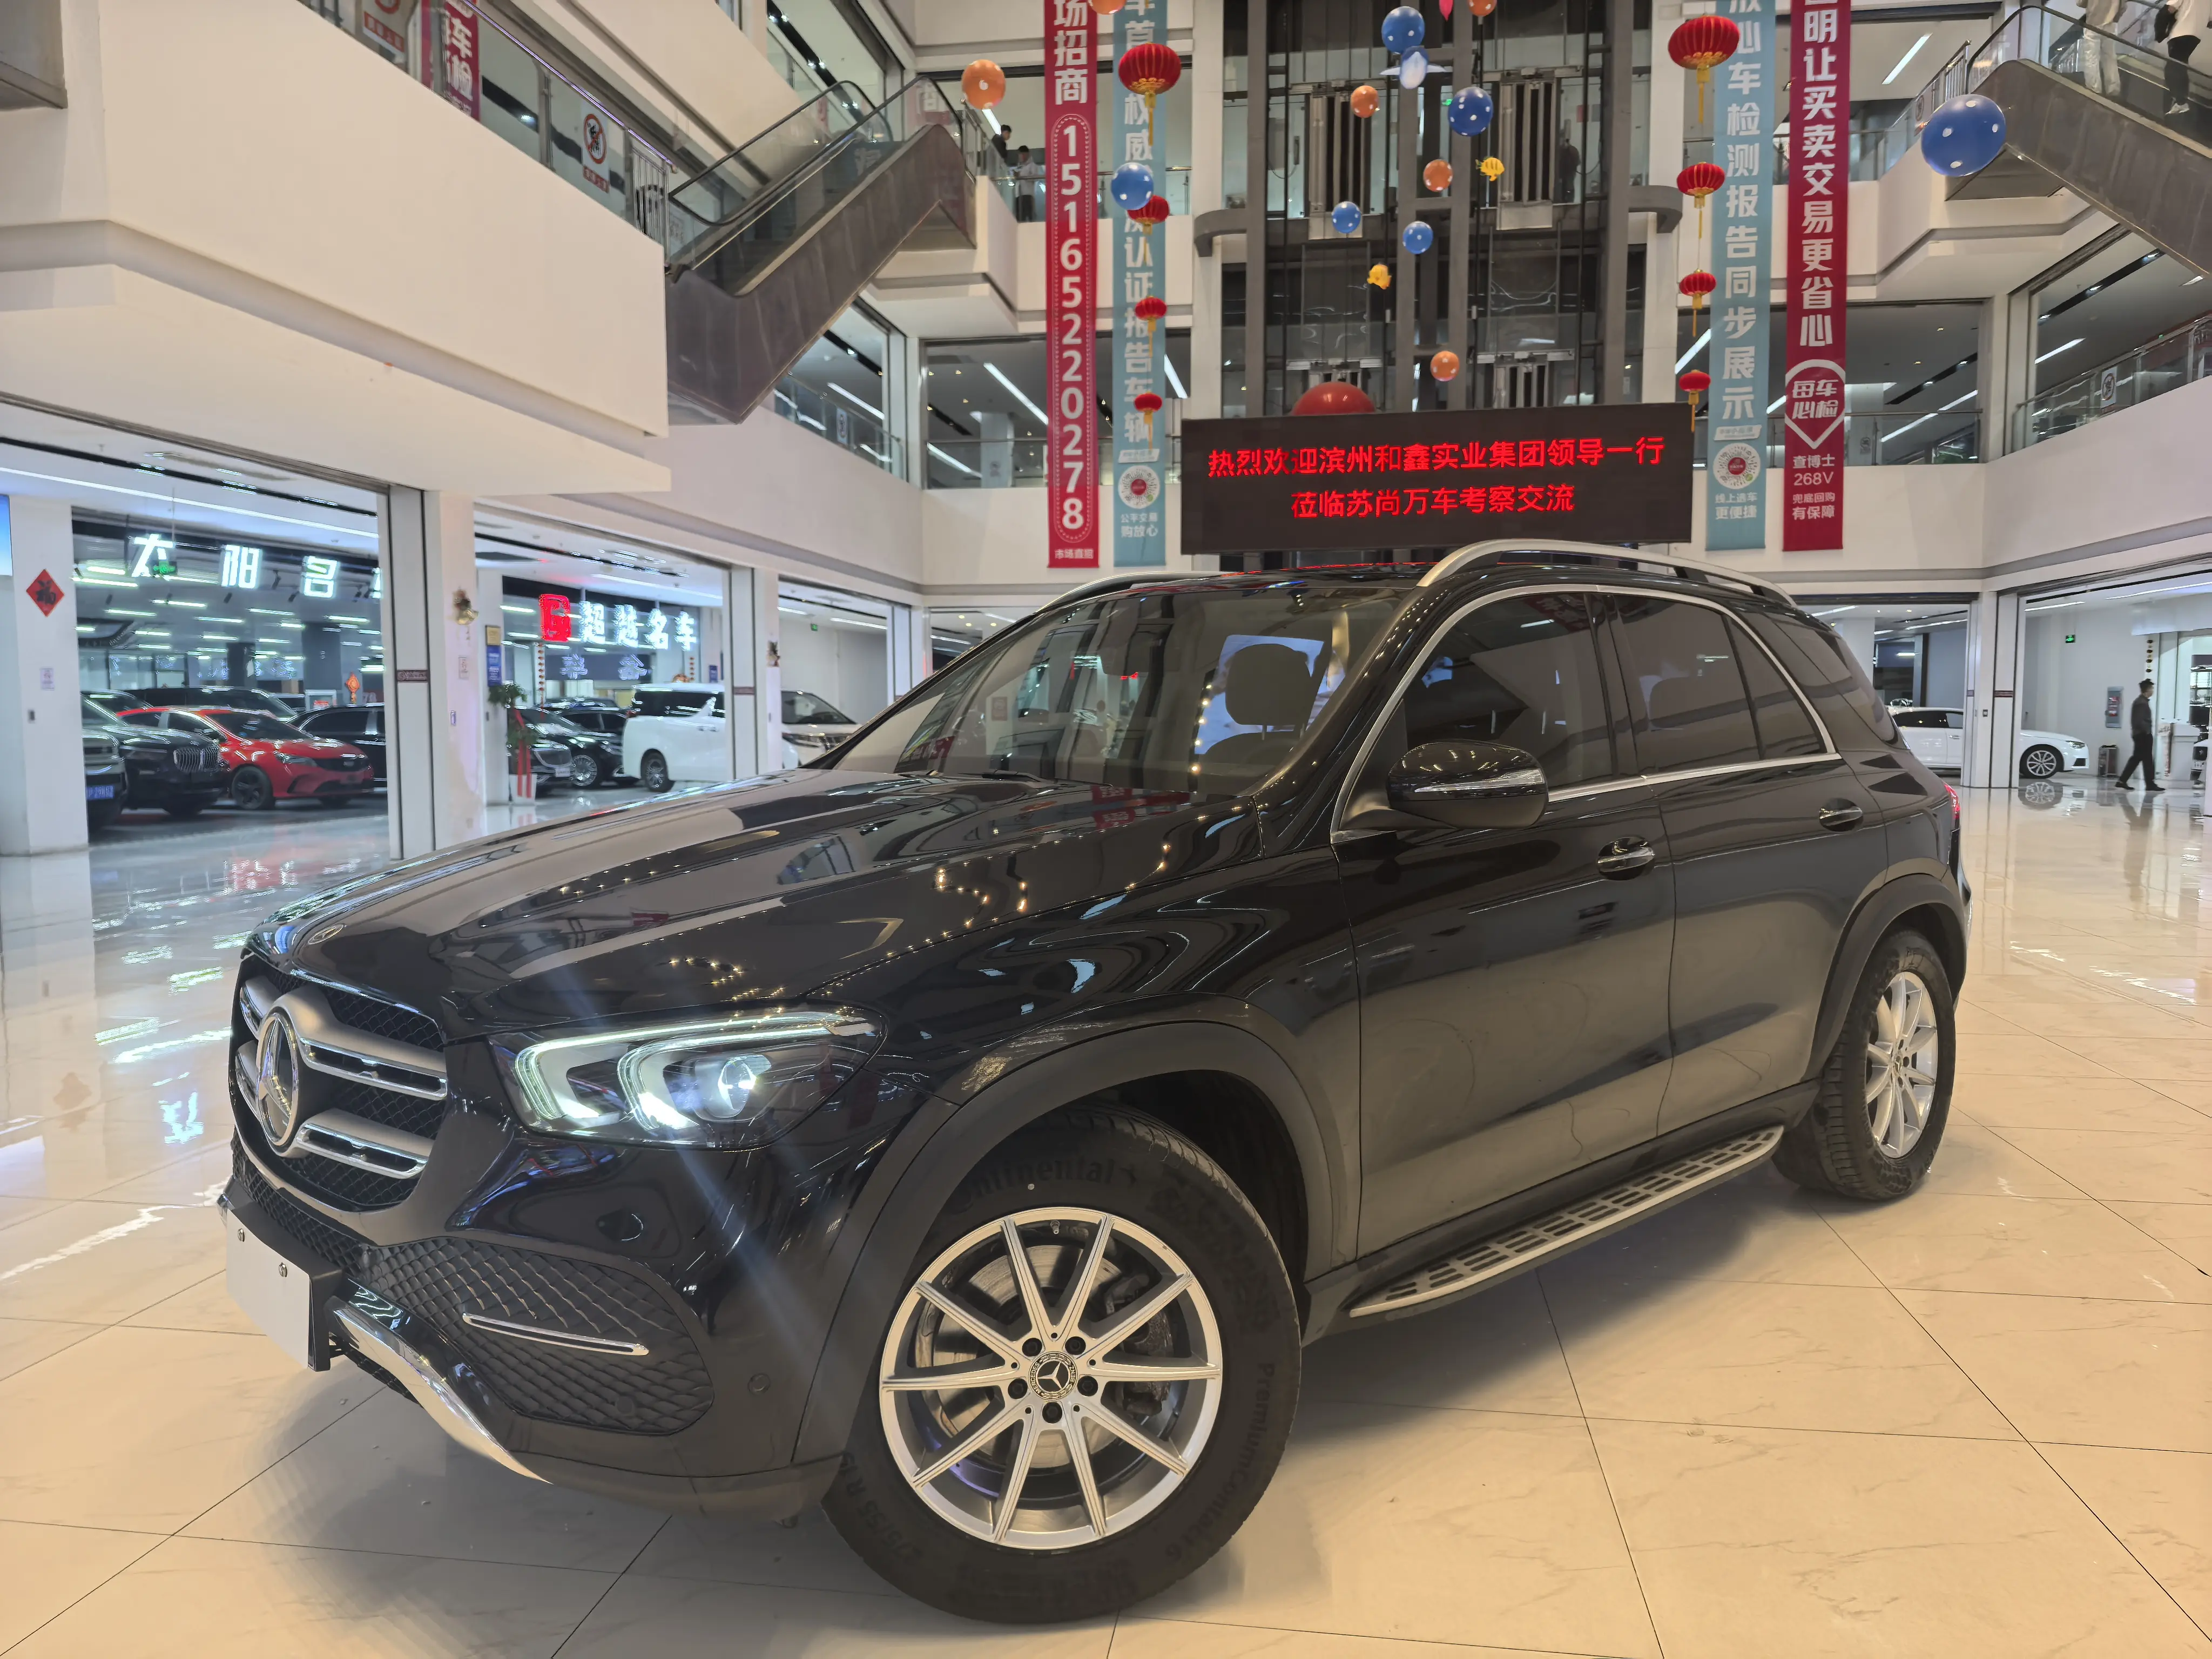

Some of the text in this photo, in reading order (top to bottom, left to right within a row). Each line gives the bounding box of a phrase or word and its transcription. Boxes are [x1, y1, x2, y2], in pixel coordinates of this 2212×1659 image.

[1800, 0, 1838, 347] 明让买卖交易更省心
[1060, 125, 1084, 529] 15165220278
[1792, 379, 1839, 398] 每车
[1792, 400, 1839, 419] 必检
[1208, 436, 1664, 477] 热烈欢迎滨州和鑫实业集团领导一行
[1793, 471, 1834, 486] 268V
[1291, 484, 1575, 520] 莅临苏尚万车考察交流
[1792, 492, 1835, 504] 兜底回购
[1792, 505, 1835, 521] 有保障
[1030, 1361, 1041, 1394] MERCEDES
